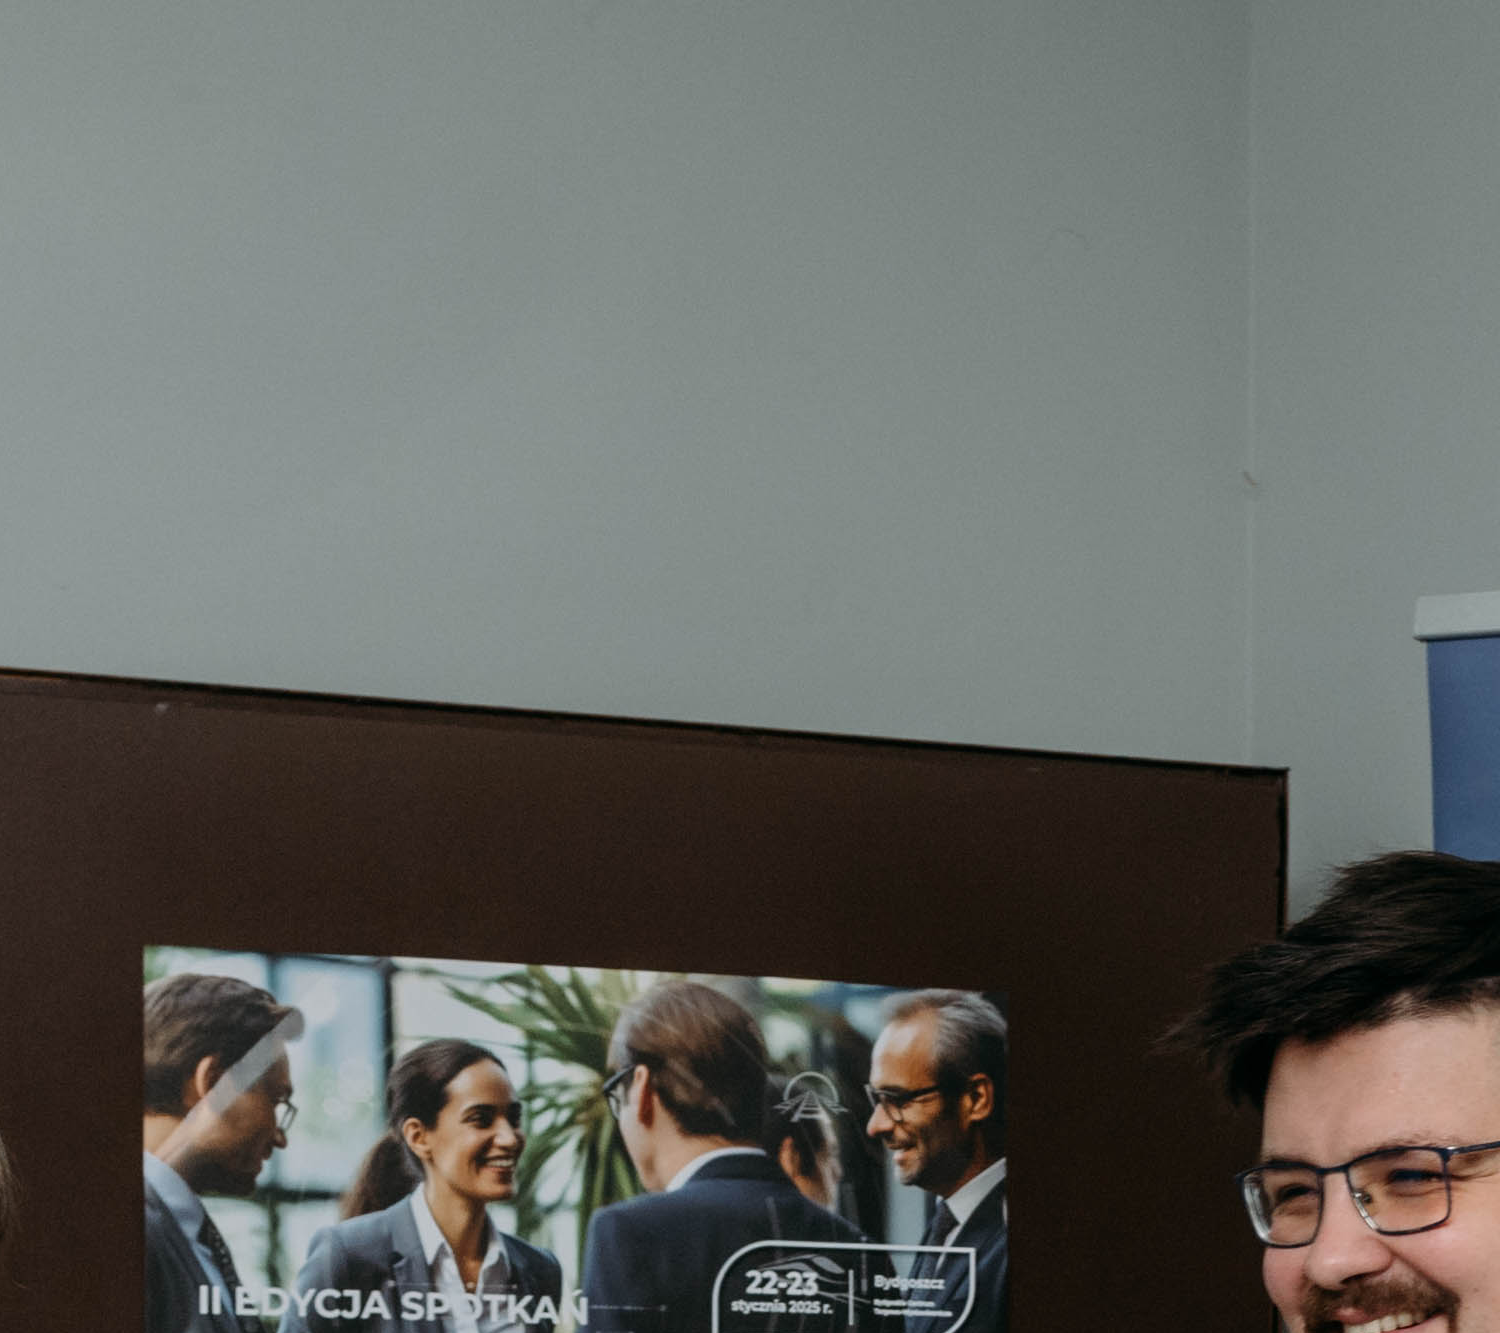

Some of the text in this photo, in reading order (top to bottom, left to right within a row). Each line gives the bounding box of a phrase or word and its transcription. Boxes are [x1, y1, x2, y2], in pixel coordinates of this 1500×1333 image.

[745, 1270, 819, 1297] 22-23
[873, 1275, 946, 1291] Bydgoszcz
[199, 1283, 588, 1326] II EDYCJA SPOTKAŃ
[731, 1300, 787, 1315] stycznia
[788, 1302, 821, 1314] 2025
